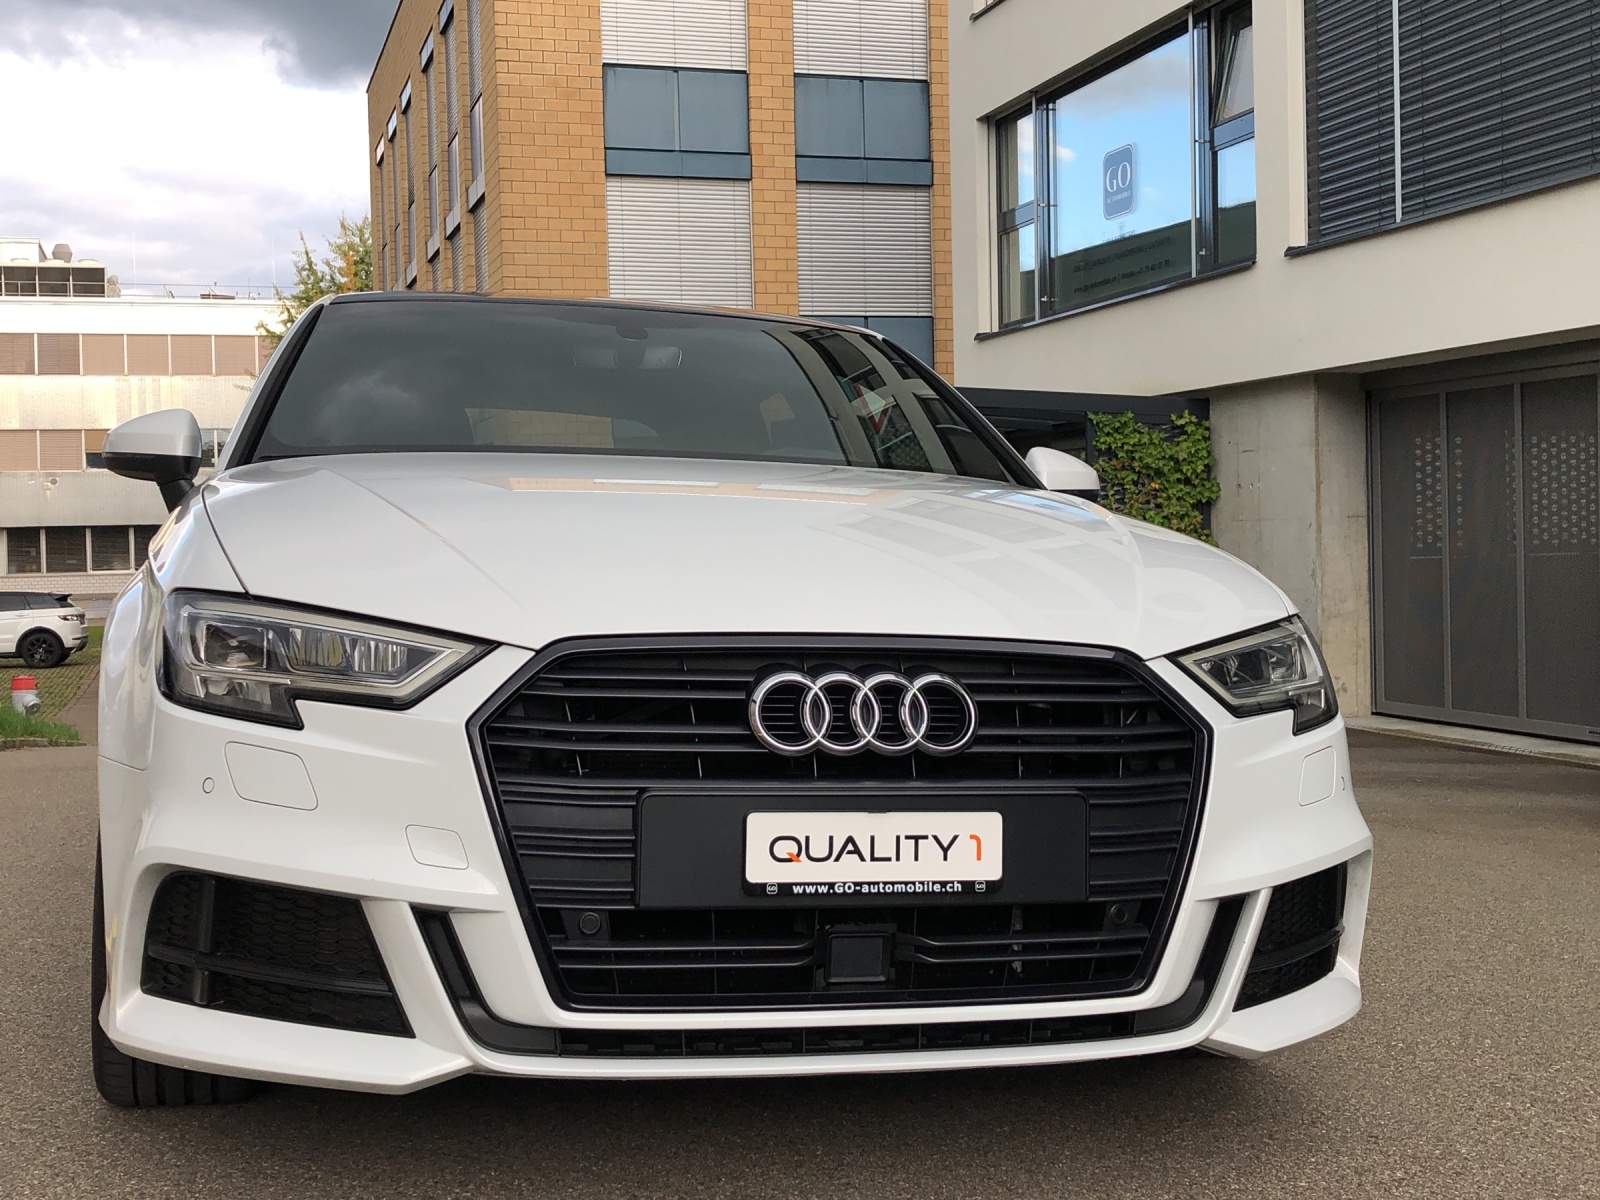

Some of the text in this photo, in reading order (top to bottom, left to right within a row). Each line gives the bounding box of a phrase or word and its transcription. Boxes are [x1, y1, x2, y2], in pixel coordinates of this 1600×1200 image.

[1106, 161, 1131, 192] GO
[769, 834, 960, 863] QUALITY
[792, 881, 962, 894] www.GO-automobile.ch
